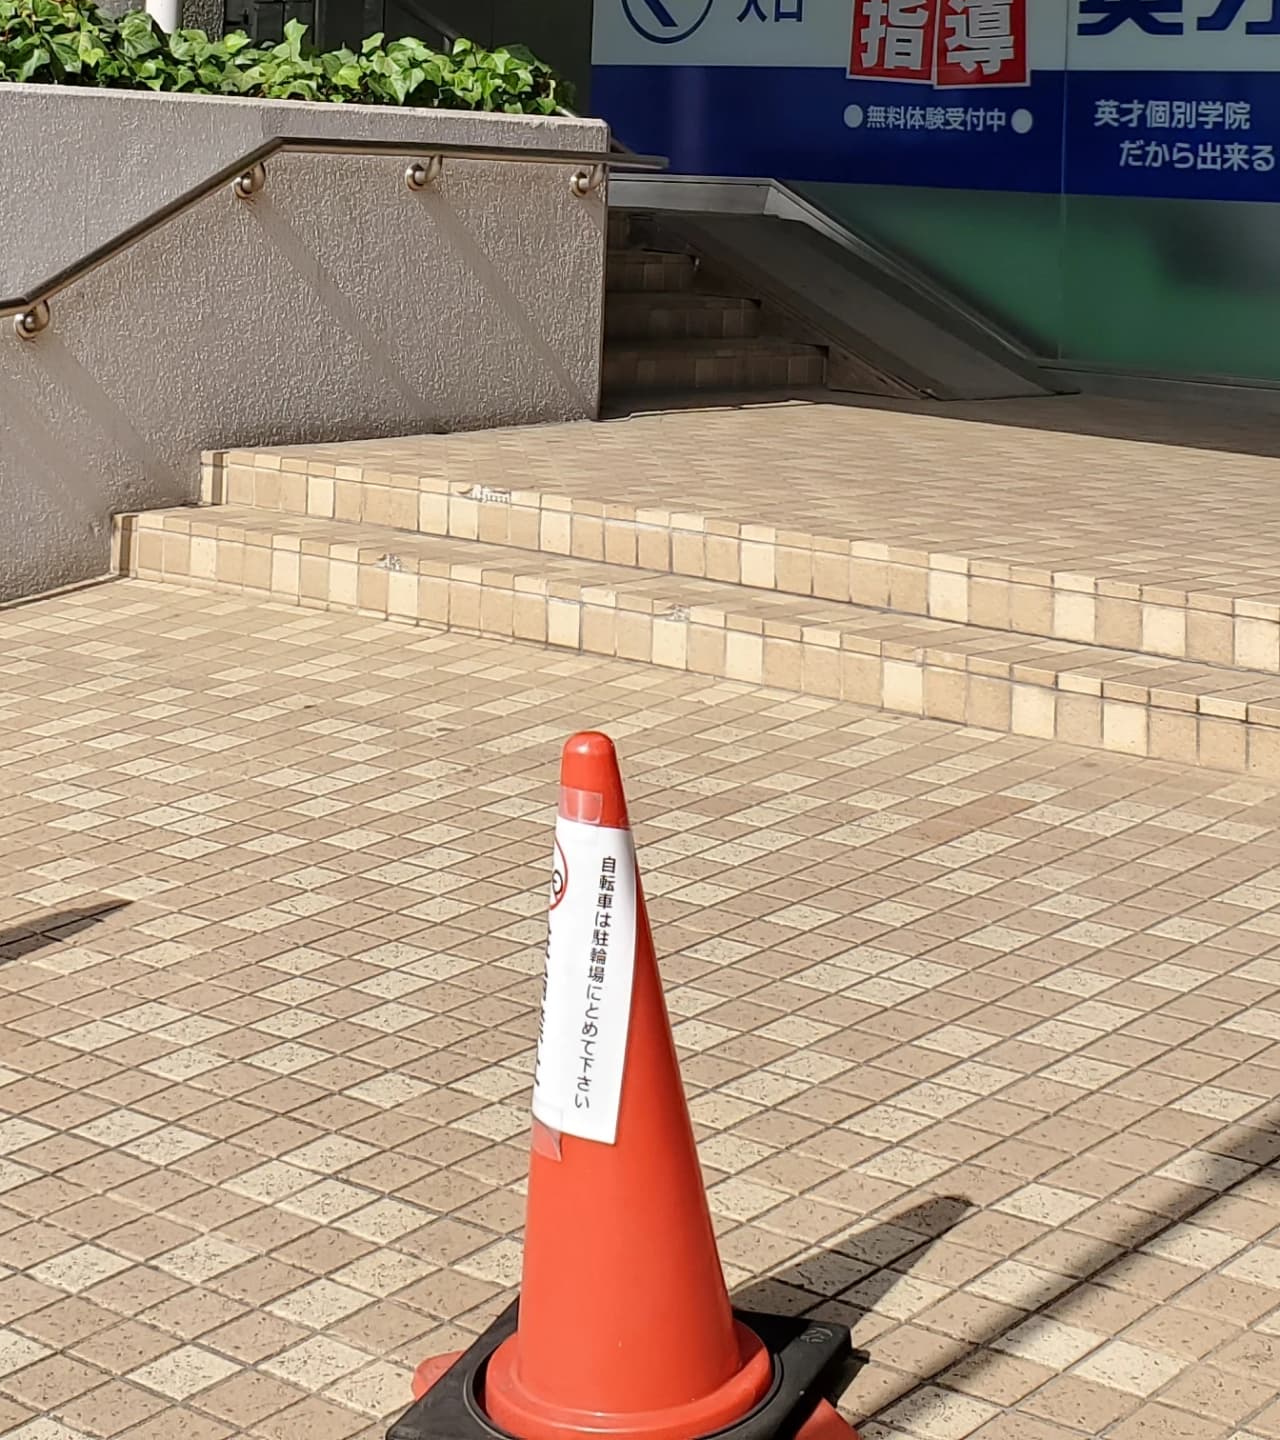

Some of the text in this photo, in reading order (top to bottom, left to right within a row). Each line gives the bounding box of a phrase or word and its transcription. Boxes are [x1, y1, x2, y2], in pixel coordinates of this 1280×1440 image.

[866, 105, 1007, 132] 無料体験受付中
[1093, 99, 1251, 130] 英才個別学院
[1119, 139, 1276, 172] だから出来る
[574, 856, 617, 1110] 自転車は駐輪場にとめて下さい
